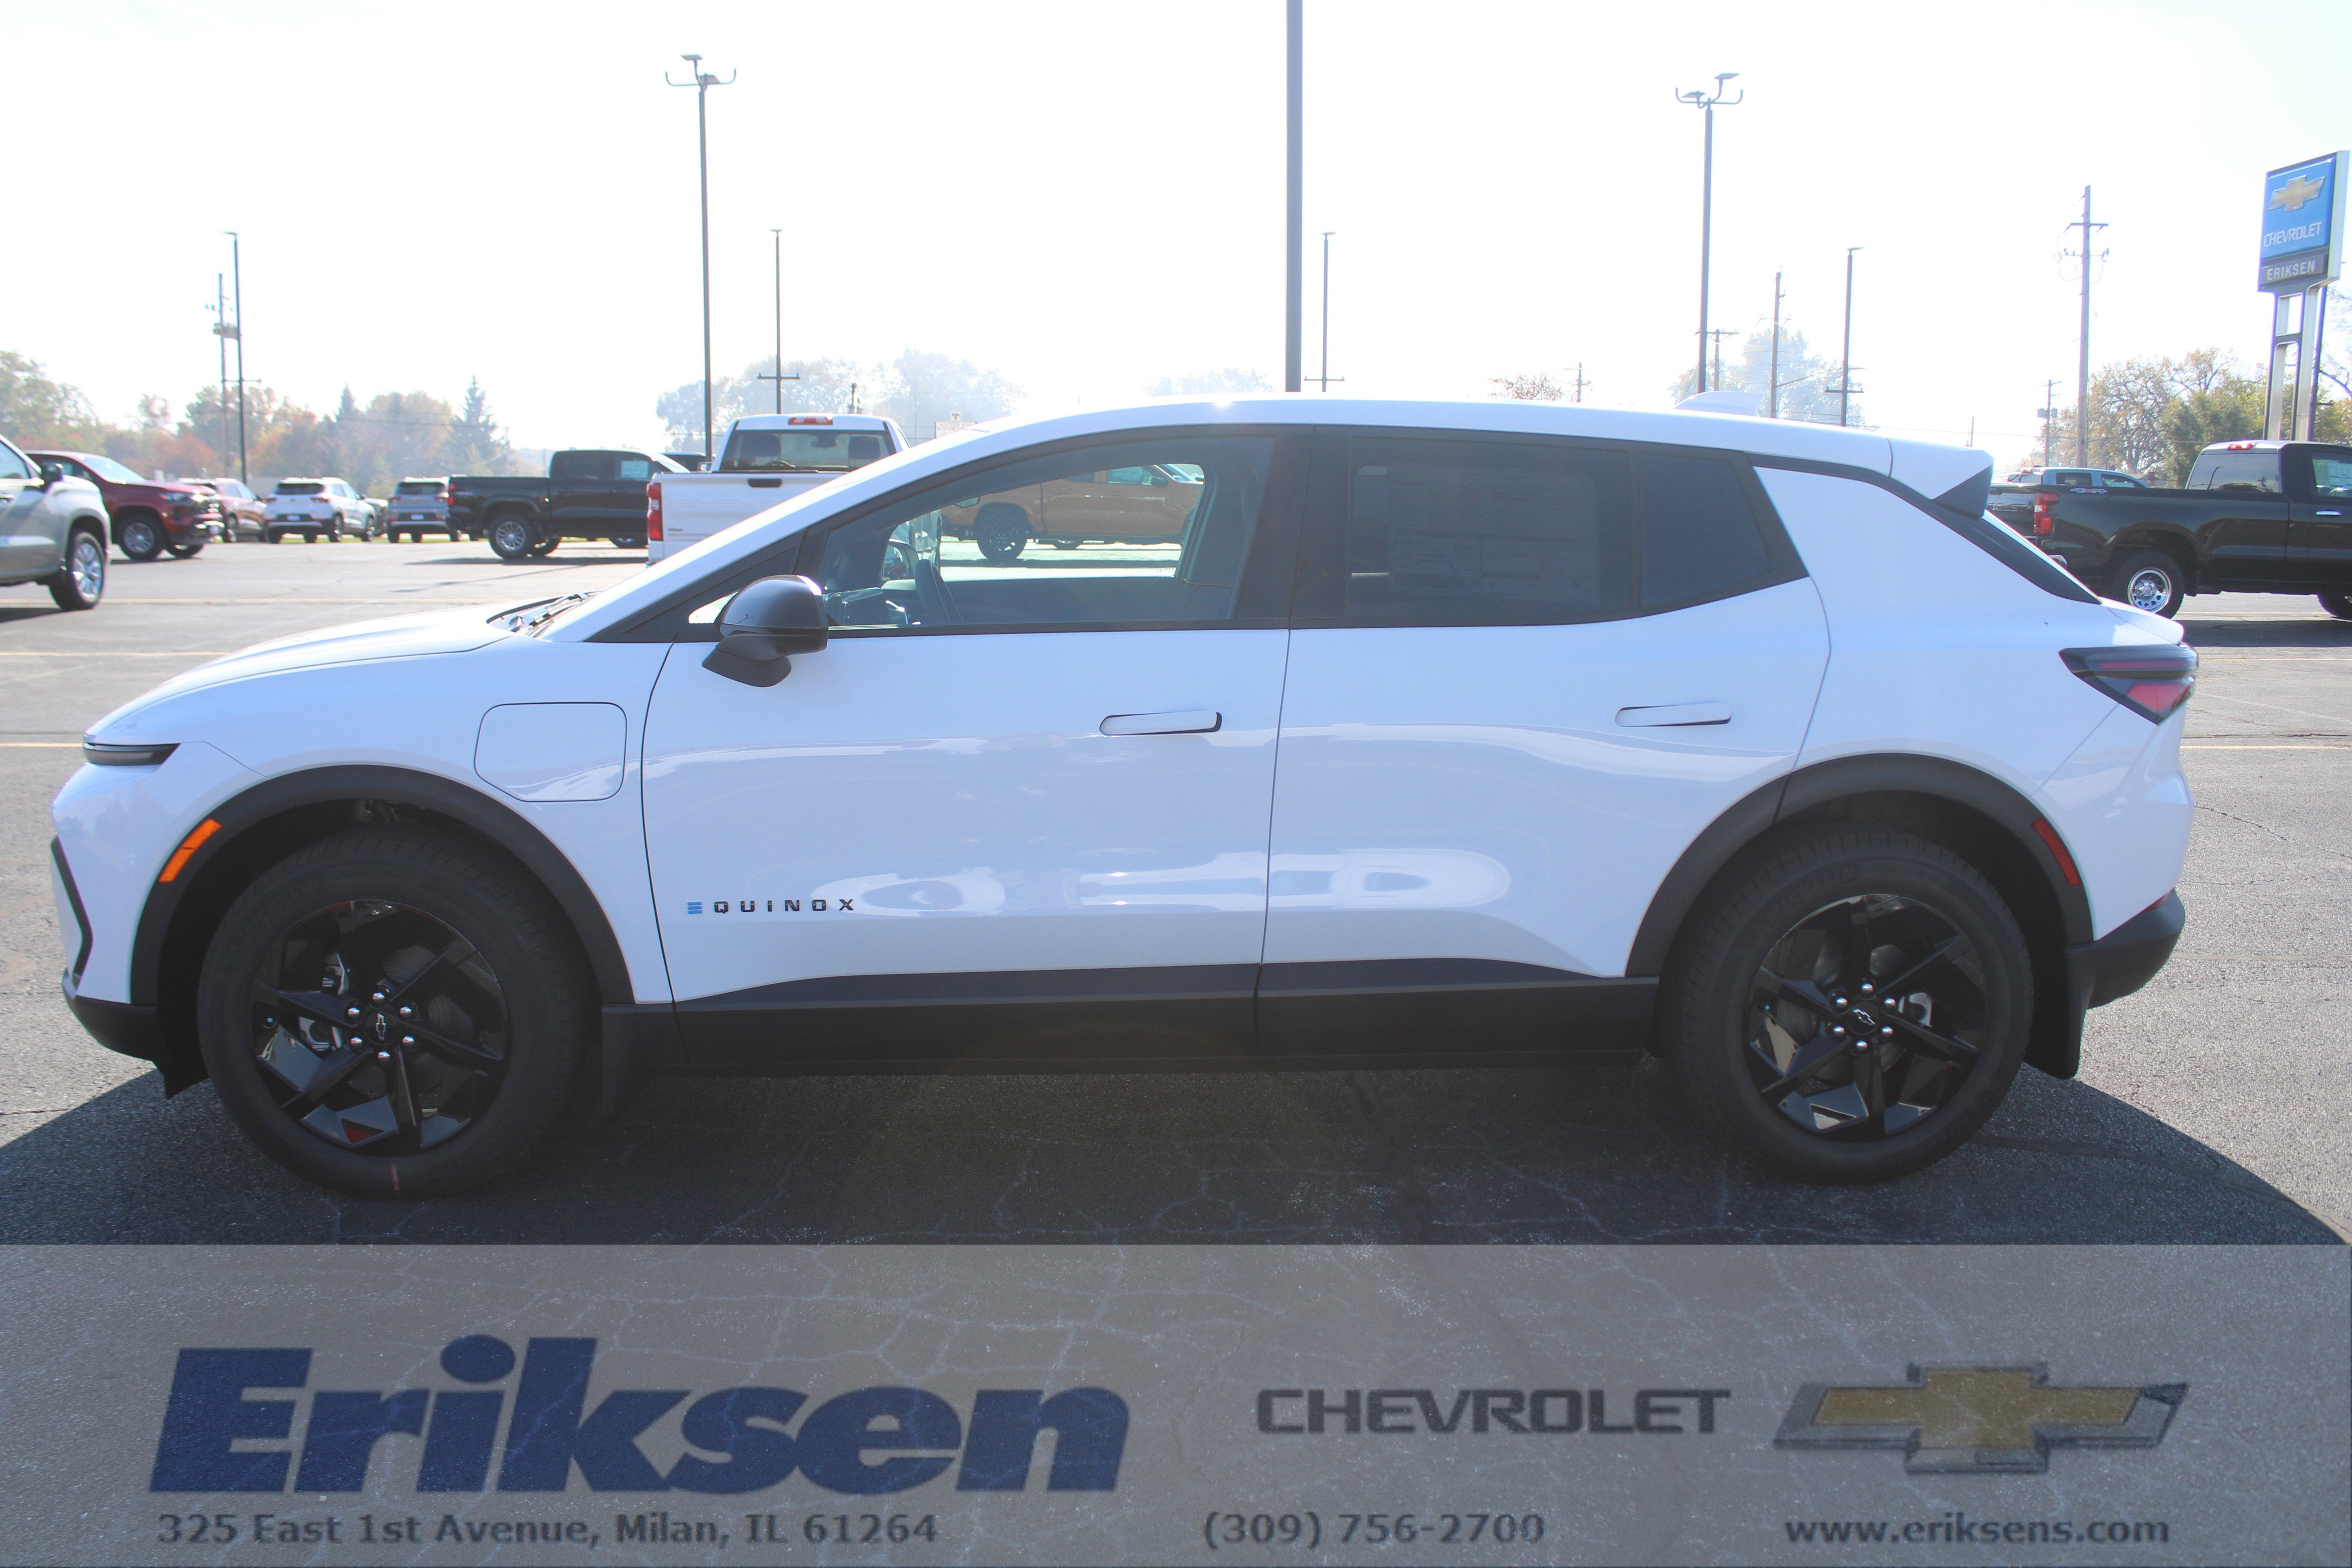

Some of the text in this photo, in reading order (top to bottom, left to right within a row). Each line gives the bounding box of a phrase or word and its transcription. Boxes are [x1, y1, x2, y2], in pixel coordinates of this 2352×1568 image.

[2263, 222, 2322, 247] CHEVROLET
[2267, 260, 2315, 281] ERIKSEN
[687, 898, 854, 914] EQUINOX
